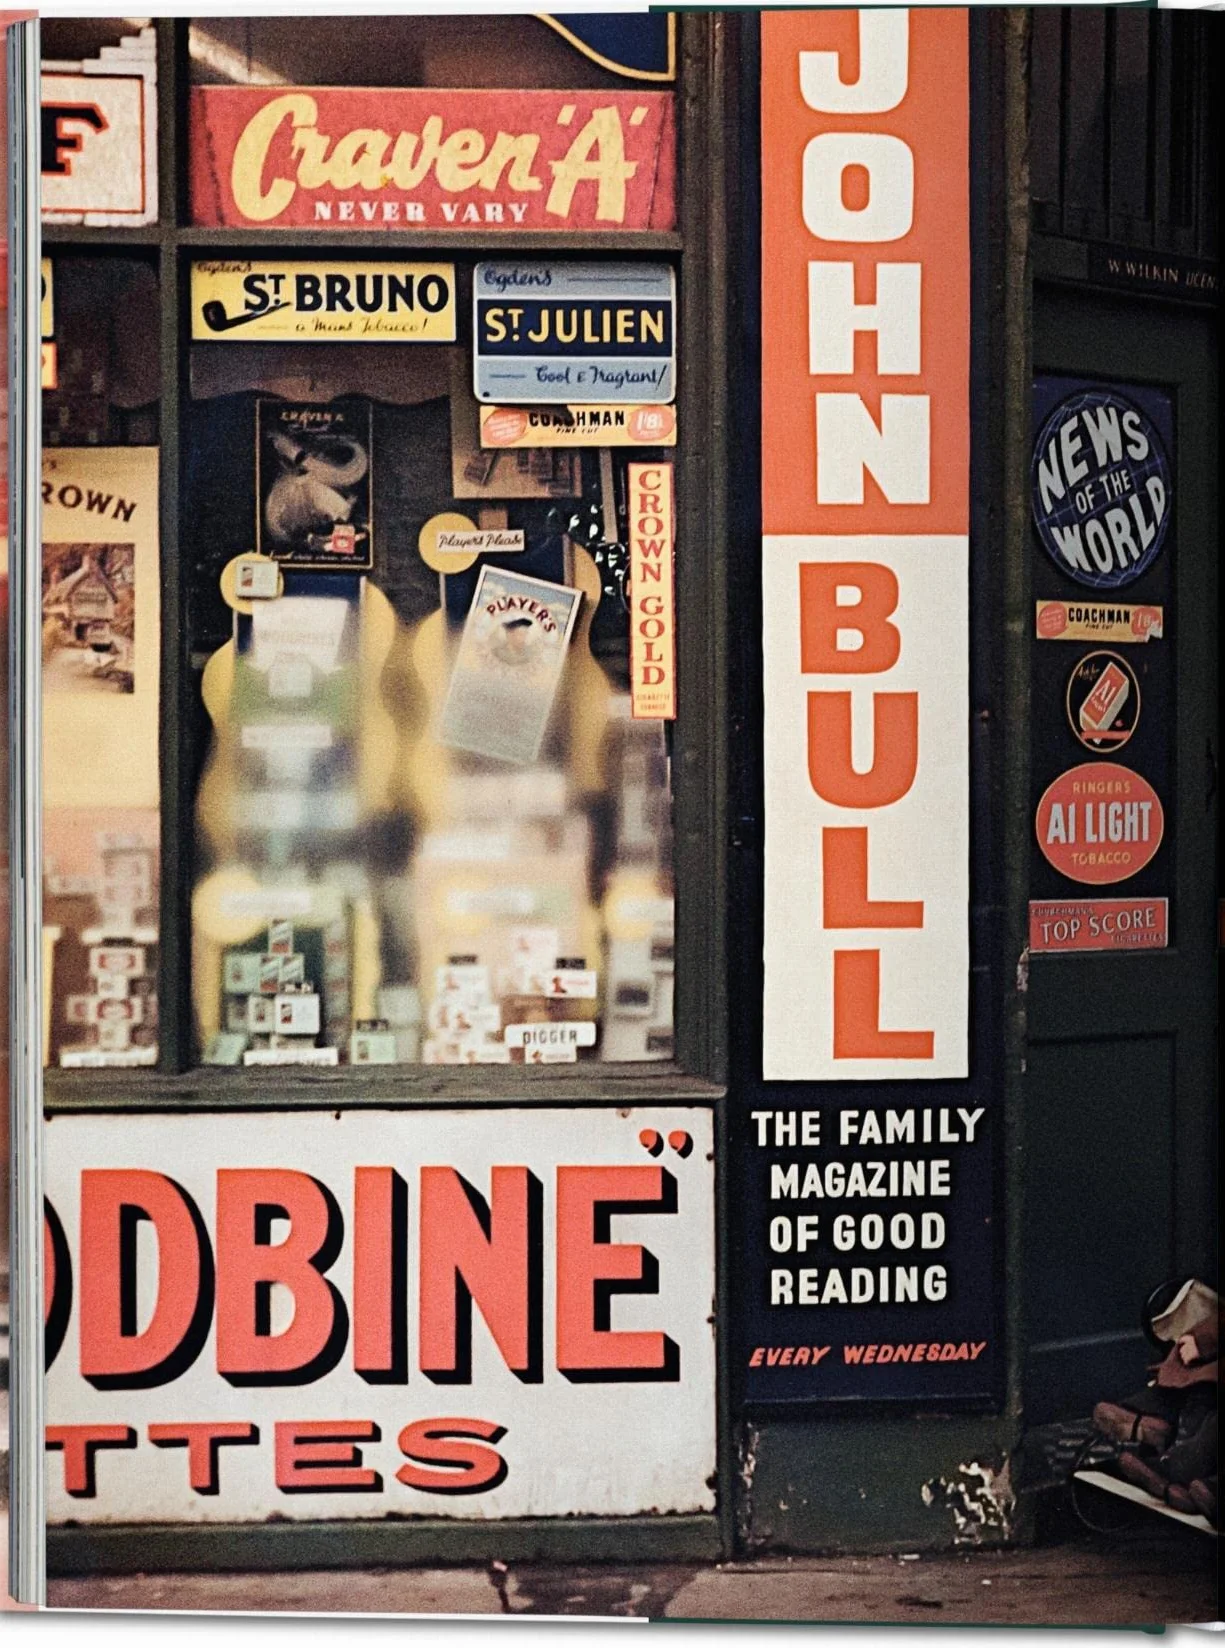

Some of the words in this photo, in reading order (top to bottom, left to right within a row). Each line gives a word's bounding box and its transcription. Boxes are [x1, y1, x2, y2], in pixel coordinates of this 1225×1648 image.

[231, 93, 544, 222] Craven
[314, 201, 426, 222] NEVER
[441, 201, 529, 223] VARY
[799, 9, 930, 504] JOHN
[1125, 261, 1179, 284] WILKIN
[295, 273, 449, 313] BRUNO
[528, 308, 664, 343] JULIEN
[535, 364, 570, 386] Cool
[529, 411, 624, 427] COAHMAN
[1038, 407, 1149, 514] NEWS
[1075, 489, 1096, 516] OF
[1098, 469, 1131, 503] THE
[637, 469, 666, 583] CROWN
[1051, 476, 1165, 575] WORLD
[1068, 608, 1130, 624] COACHMAN
[638, 596, 665, 686] GOLD
[799, 562, 934, 1059] BULL
[1085, 802, 1152, 843] LIGHT
[1071, 852, 1131, 866] TOBACCO
[1041, 918, 1080, 944] TOP
[1089, 908, 1156, 937] SCORE
[522, 1029, 578, 1045] DIGGER
[751, 1110, 821, 1147] THE
[840, 1108, 985, 1146] FAMILY
[770, 1160, 950, 1199] MAGAZINE
[769, 1215, 819, 1253] OF
[832, 1212, 946, 1252] GOOD
[770, 1265, 947, 1305] READING
[749, 1346, 831, 1368] EVERY
[843, 1341, 987, 1365] WEDNESDAY
